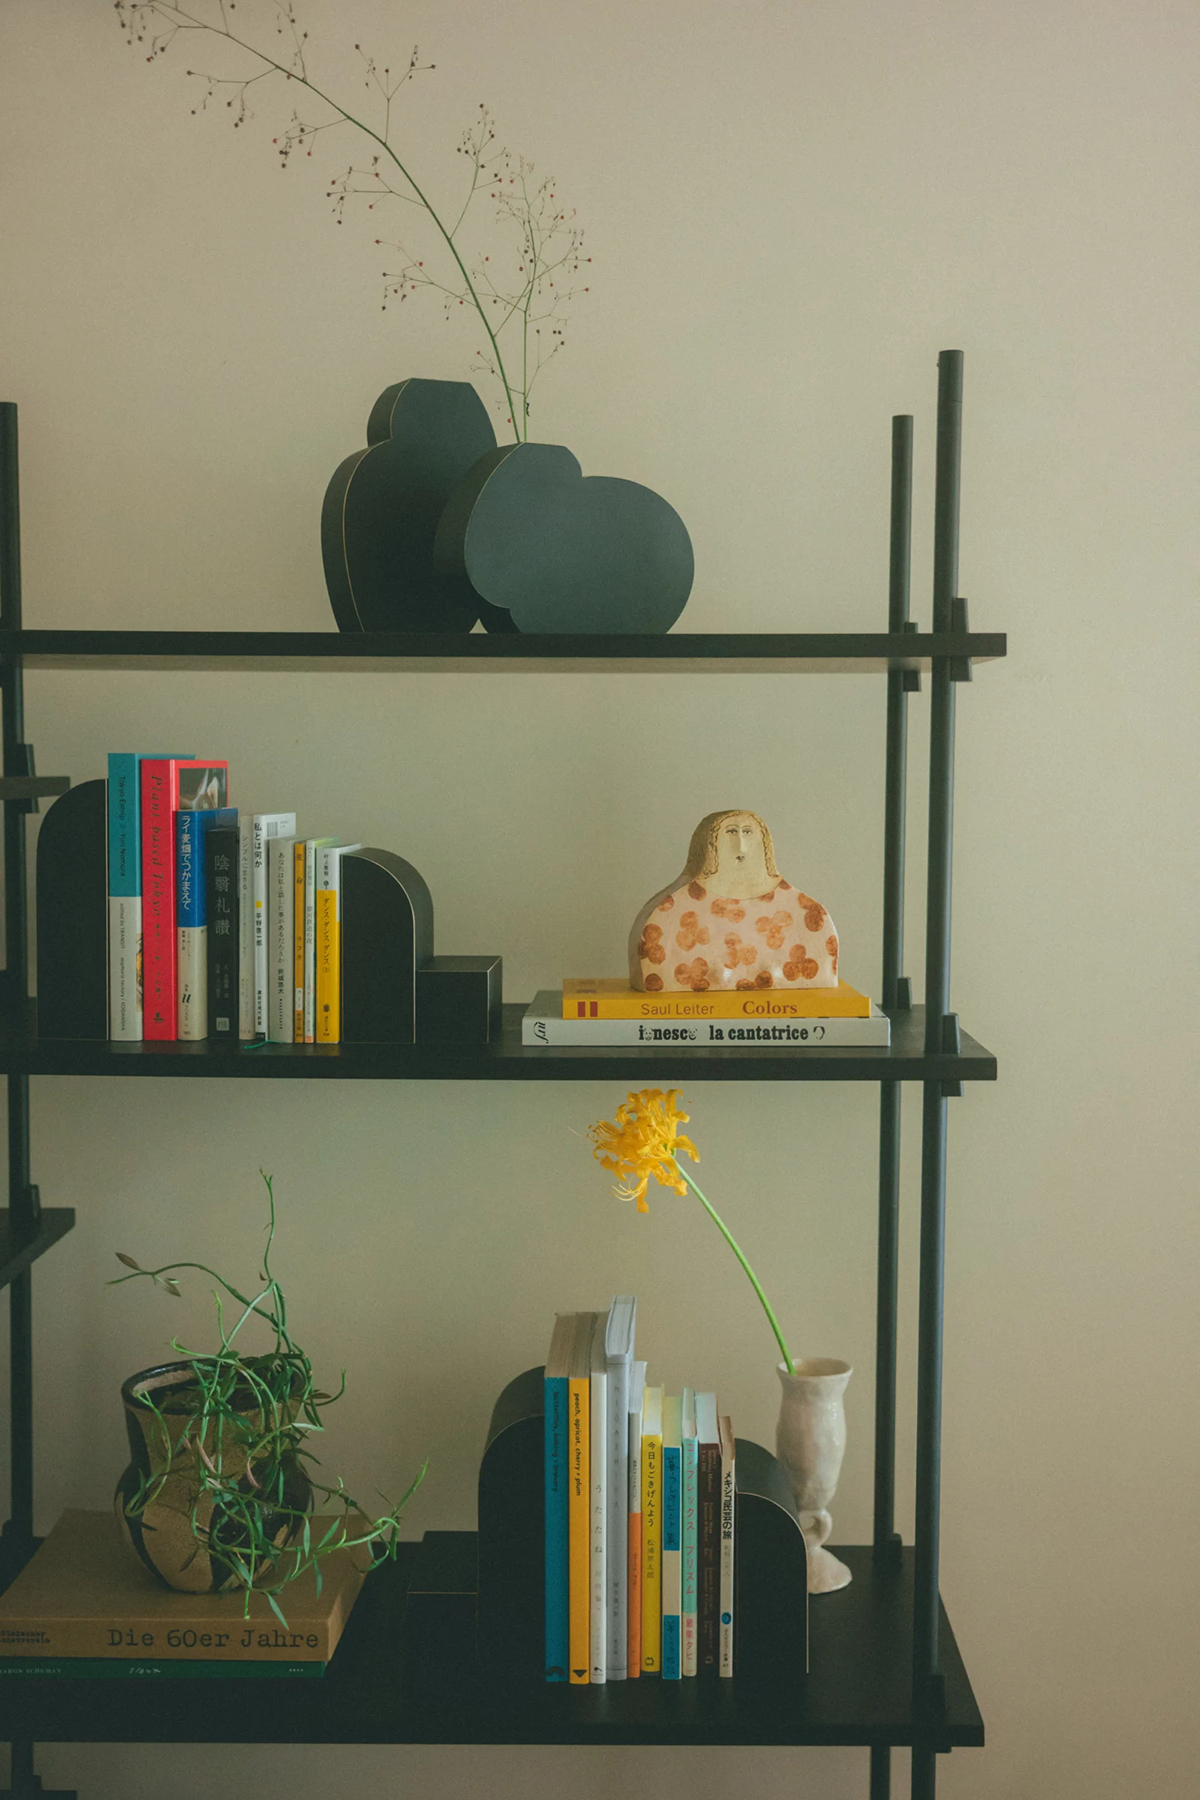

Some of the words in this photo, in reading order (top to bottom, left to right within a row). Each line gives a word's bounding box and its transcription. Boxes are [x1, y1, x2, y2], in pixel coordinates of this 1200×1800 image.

[253, 822, 263, 868] 私とは何か
[181, 815, 192, 911] ライ麦畑でつかまえて
[150, 872, 164, 917] Tokyo
[640, 1003, 671, 1016] Saul
[675, 1003, 715, 1016] Leiter
[742, 1000, 798, 1015] Colors
[708, 1024, 724, 1041] la
[728, 1024, 809, 1041] cantatrice
[573, 1392, 581, 1417] peach,
[573, 1418, 582, 1446] apricot,
[574, 1448, 583, 1471] cherry
[574, 1477, 583, 1497] plum
[646, 1441, 656, 1527] 今日もごきげんよう
[594, 1484, 603, 1553] うたたね
[722, 1471, 733, 1540] メキシコ民芸の旅
[106, 1628, 154, 1647] Die
[166, 1629, 230, 1648] 60er
[241, 1629, 319, 1648] Jahre
